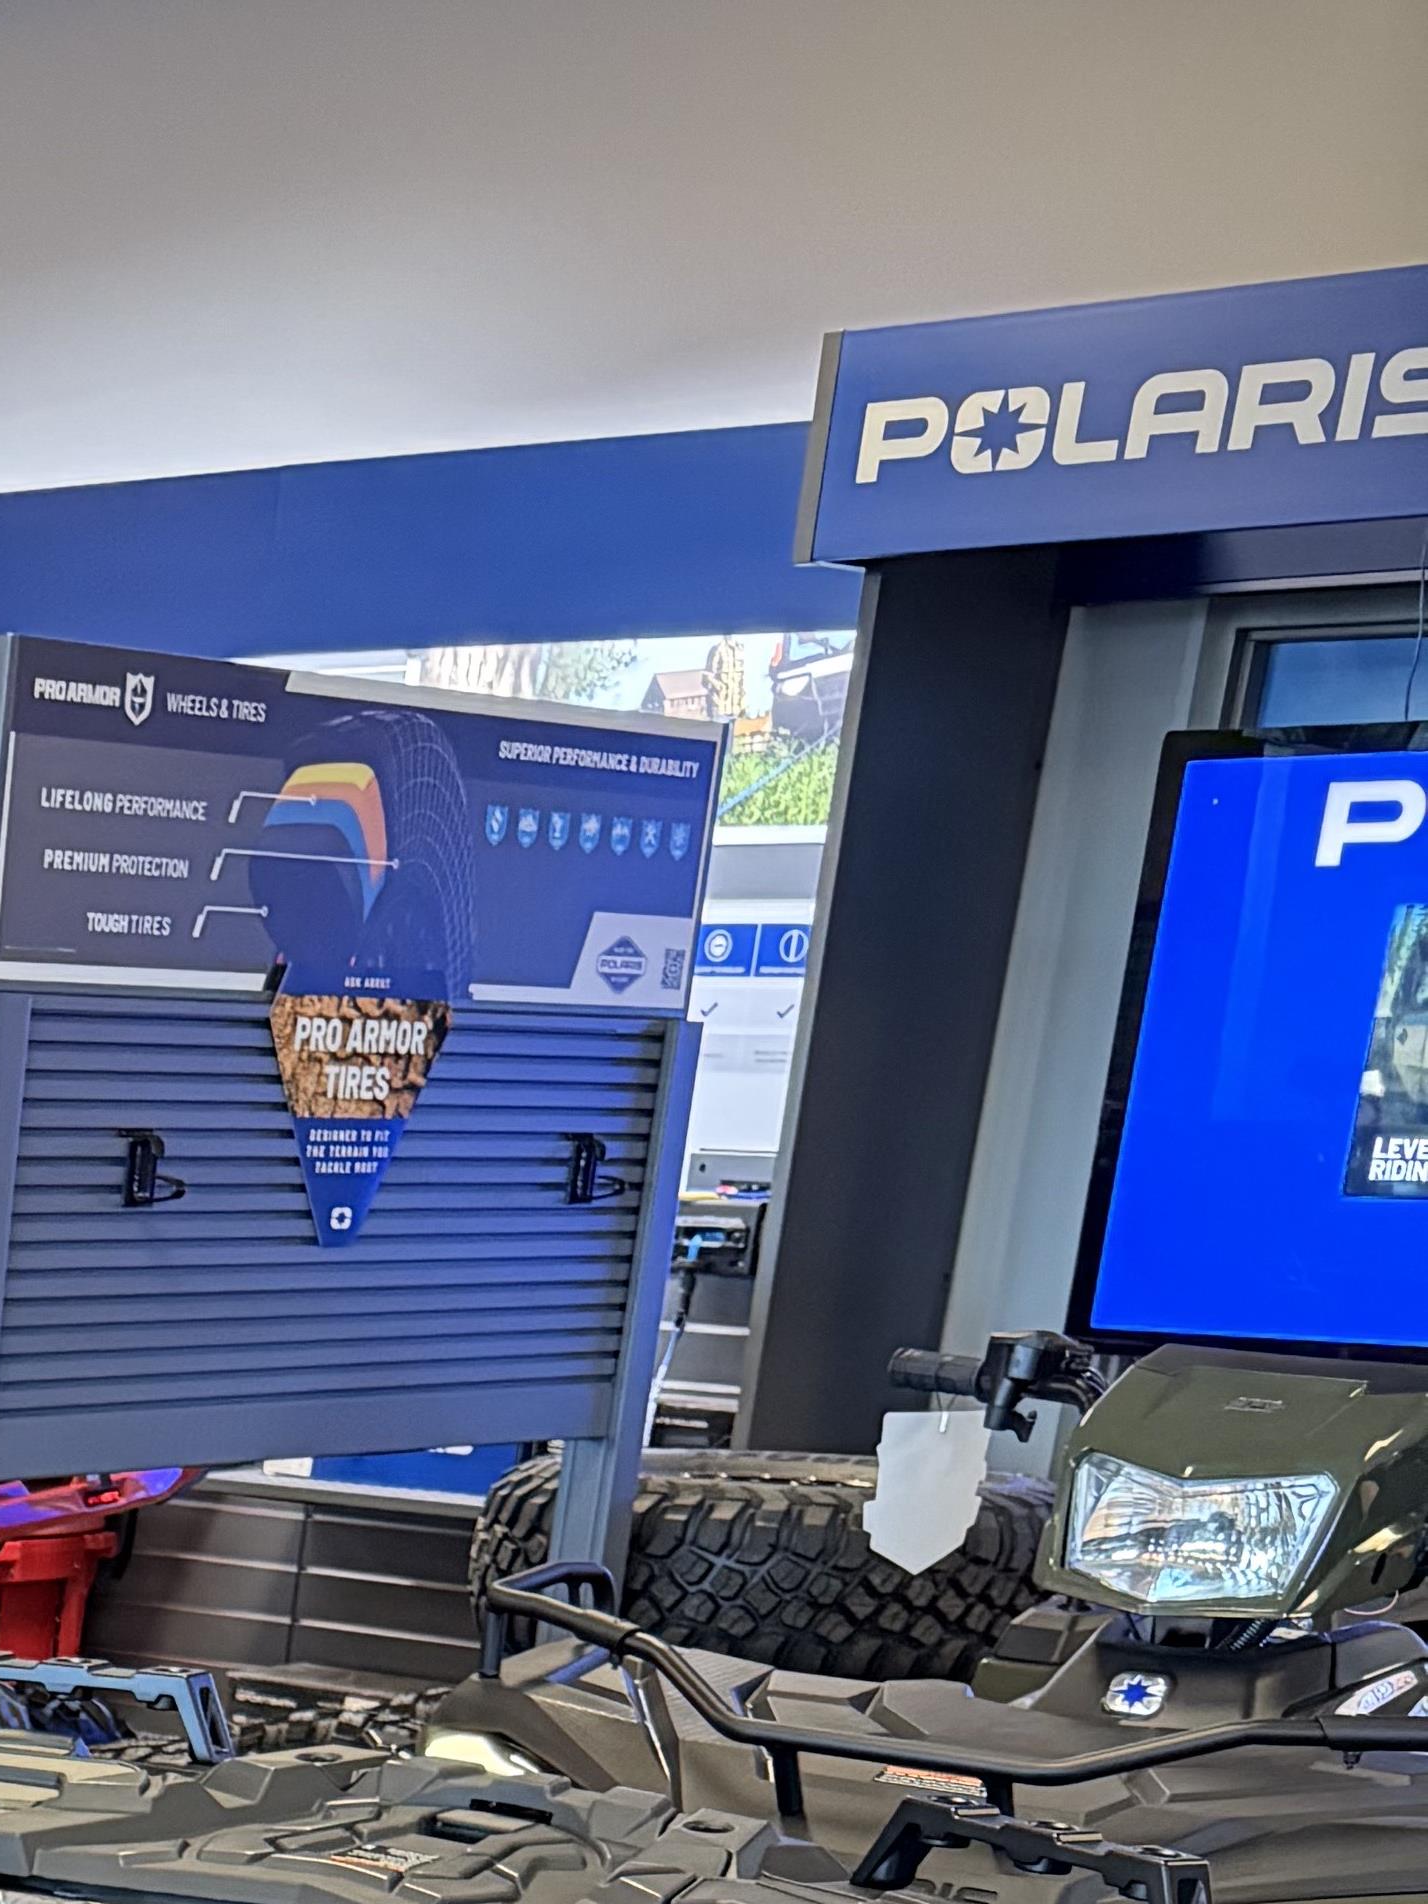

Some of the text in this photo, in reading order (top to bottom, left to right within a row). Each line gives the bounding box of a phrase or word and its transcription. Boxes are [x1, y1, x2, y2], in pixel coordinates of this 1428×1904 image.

[166, 692, 218, 718] WHEELS
[219, 698, 229, 719] &
[231, 700, 266, 722] TIRES
[498, 740, 552, 763] SUPERIOR
[552, 747, 628, 771] PERFORMANCE
[639, 756, 700, 778] DURABILITY
[40, 787, 208, 821] LIFELONG PERFORMANCE
[43, 849, 189, 878] PREMIUM PROTECTION
[86, 912, 172, 936] TOUGH TIRES
[294, 1015, 428, 1055] PRO ARMOR
[325, 1065, 391, 1101] TIRES
